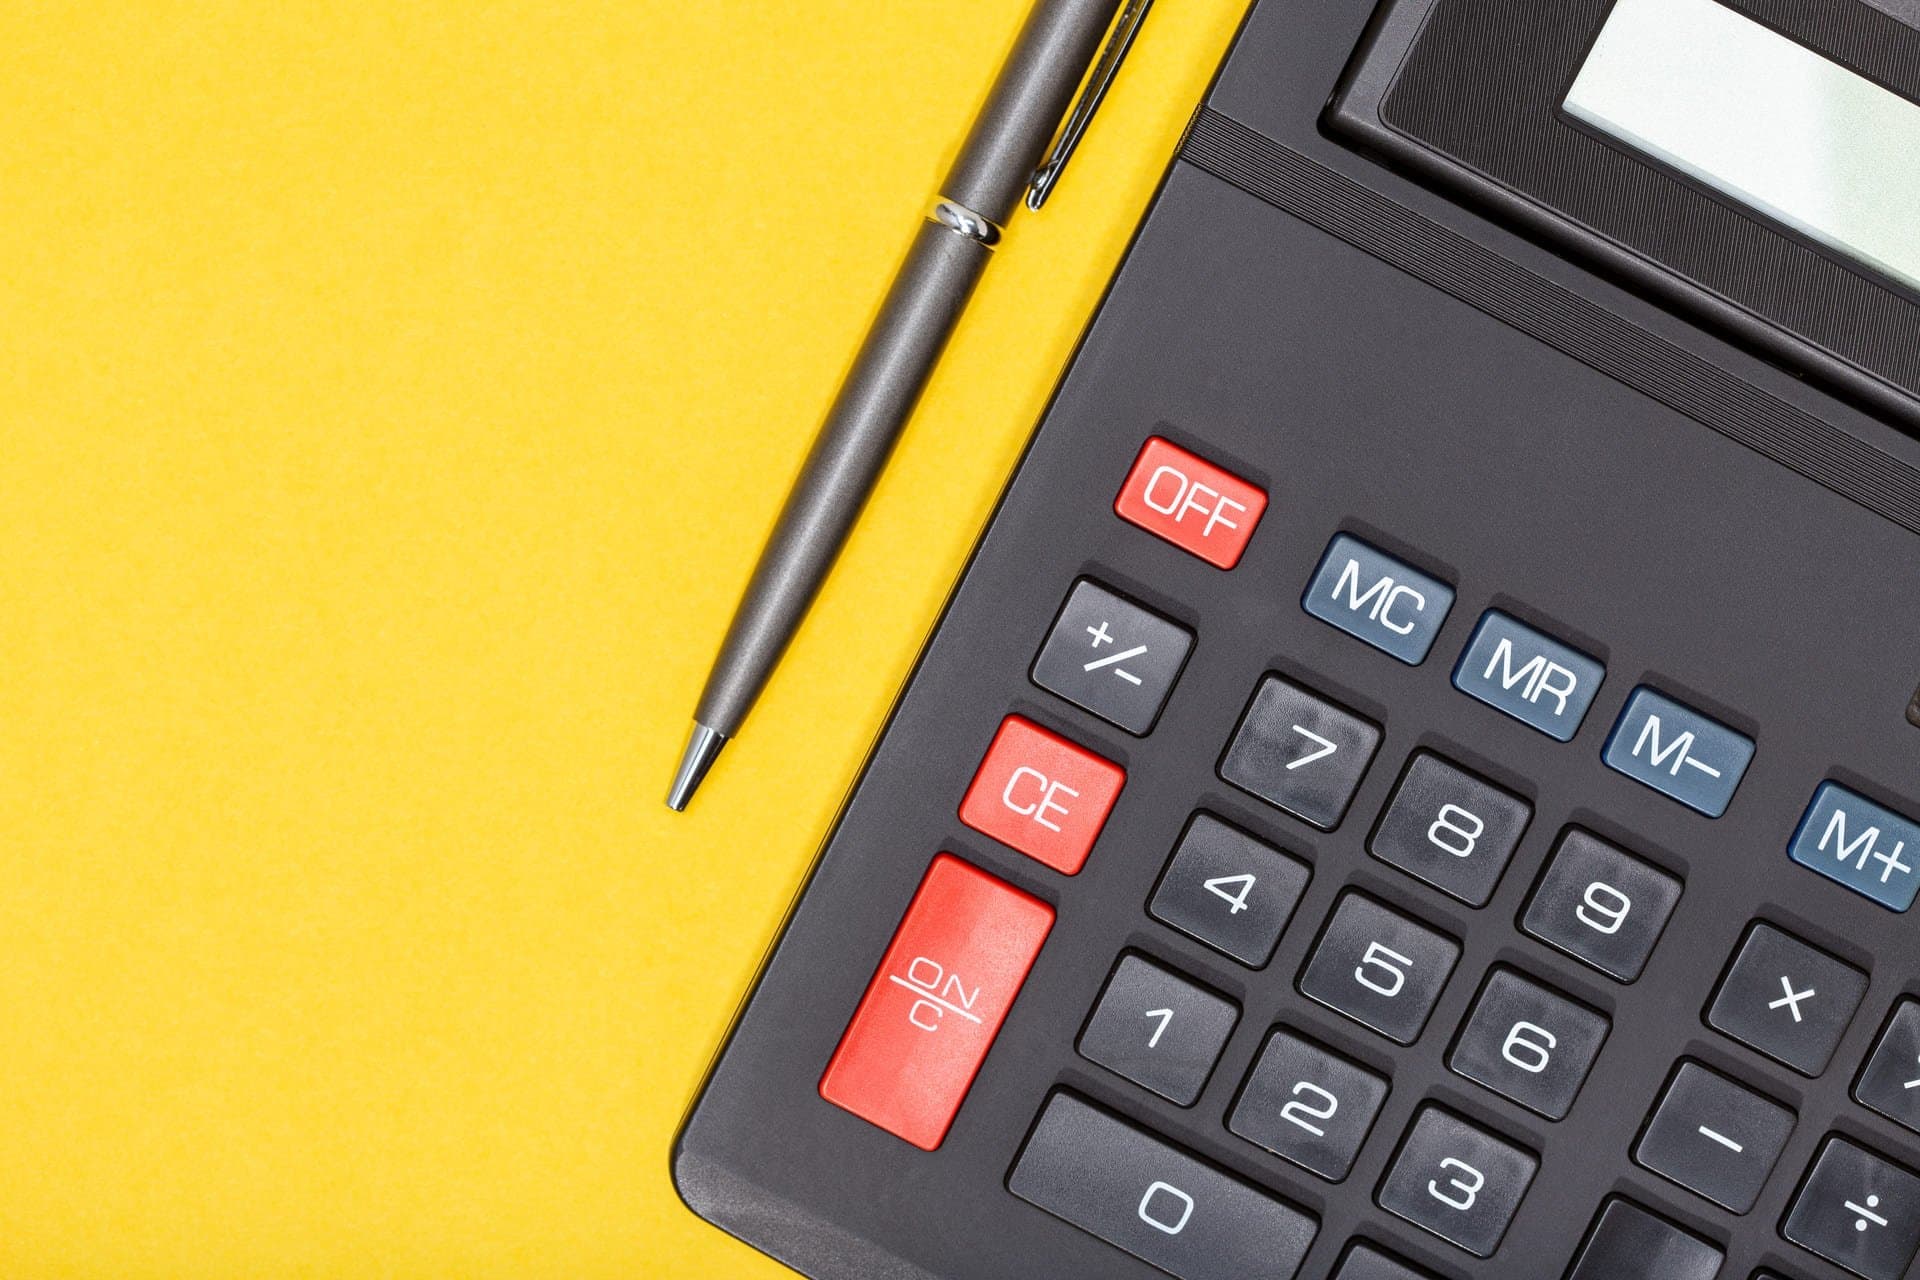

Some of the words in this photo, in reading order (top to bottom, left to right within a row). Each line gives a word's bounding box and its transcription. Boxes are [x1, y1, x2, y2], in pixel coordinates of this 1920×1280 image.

[1143, 465, 1247, 537] OFF
[1331, 558, 1426, 636] MC
[1483, 637, 1577, 716] MR
[1286, 724, 1338, 770] 7
[1631, 714, 1721, 778] M-
[1002, 765, 1080, 833] CE
[1427, 803, 1484, 858] 8
[1817, 809, 1911, 883] M+
[1203, 873, 1257, 915] 4
[1575, 881, 1631, 934] 9
[908, 957, 980, 1009] ON
[1354, 941, 1414, 997] 5
[909, 999, 943, 1032] C
[1145, 1007, 1175, 1049] 1
[1502, 1021, 1557, 1073] 6
[1279, 1081, 1338, 1137] 2
[1428, 1157, 1485, 1211] 3
